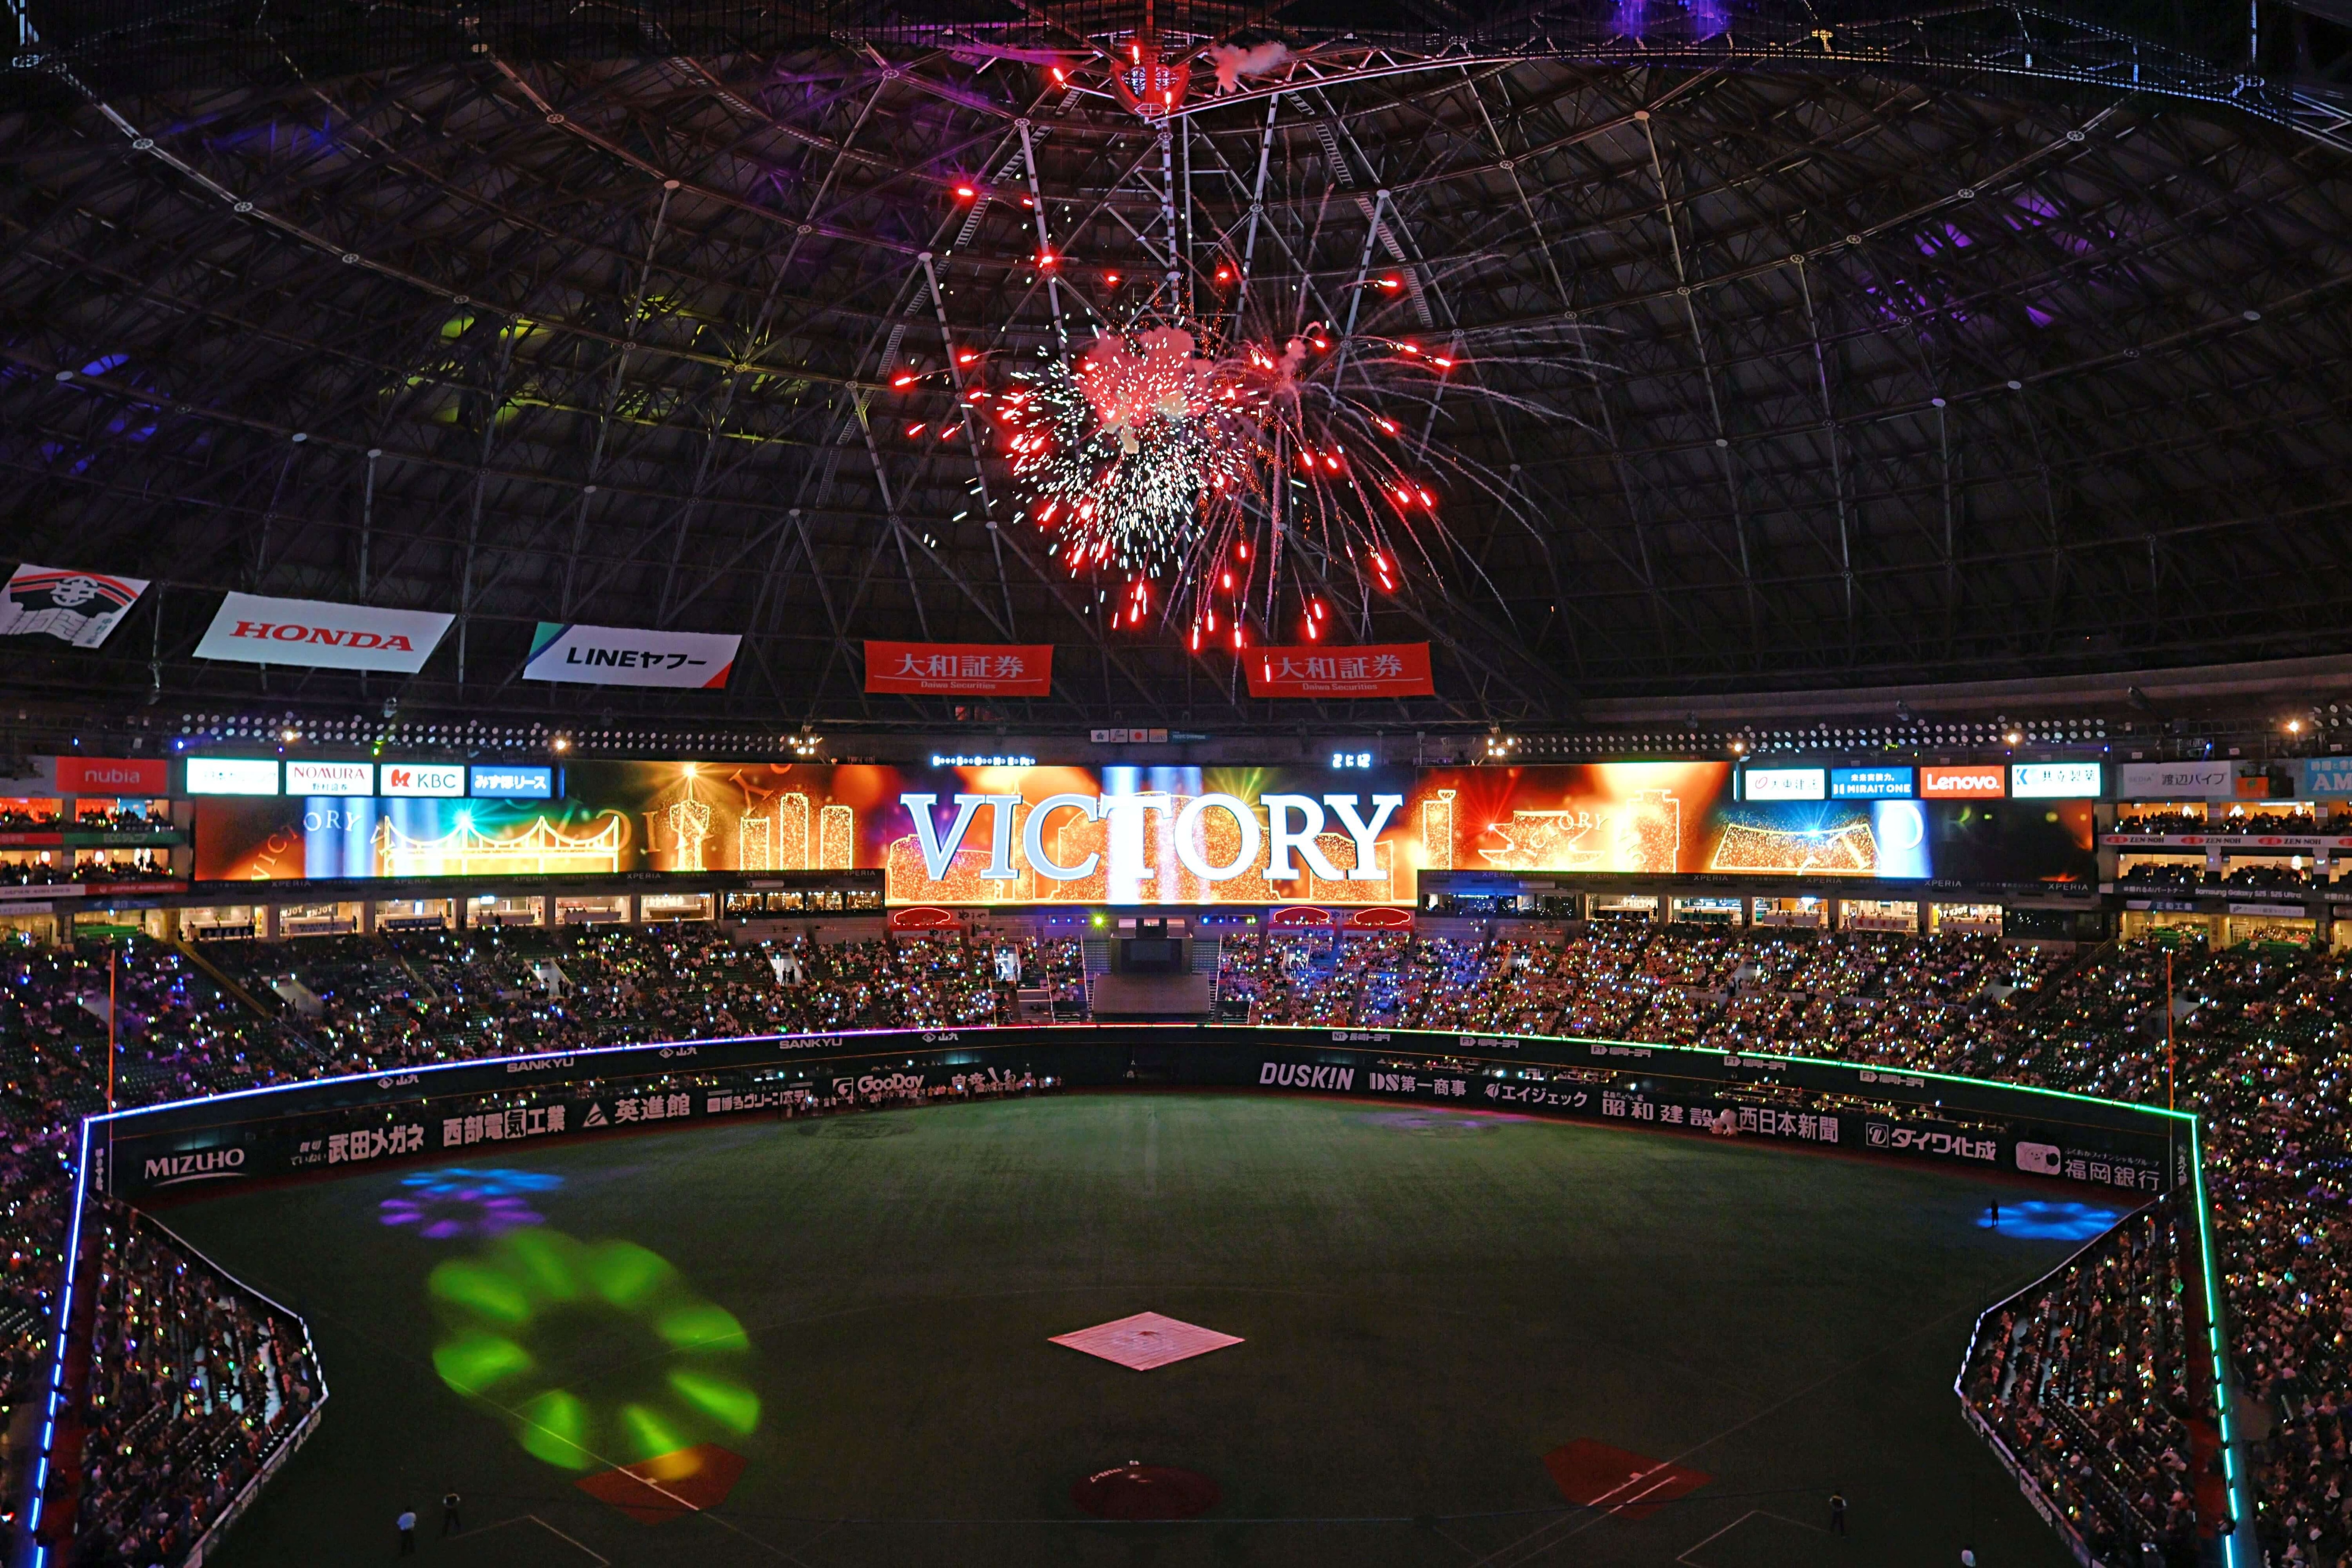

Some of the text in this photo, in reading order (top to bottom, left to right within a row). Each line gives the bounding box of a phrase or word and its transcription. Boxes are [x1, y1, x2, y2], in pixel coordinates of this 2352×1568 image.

[230, 620, 414, 652] HONDA
[566, 646, 707, 670] LINEヤフー
[895, 653, 1024, 678] 大和証券
[1274, 654, 1402, 679] 大和証券
[85, 767, 140, 783] nubia
[294, 766, 365, 780] NOMURA
[417, 773, 456, 789] KBC
[474, 773, 547, 789] みずほリース
[1927, 773, 1996, 790] Lenovo
[1847, 783, 1911, 793] MIRAIT ONE
[900, 793, 1403, 881] VICTORY
[2195, 888, 2227, 897] Samsung
[779, 1038, 842, 1050] SANKYU
[938, 1032, 958, 1041] 山九
[676, 1047, 697, 1057] 山九
[507, 1058, 574, 1073] SANKYU
[396, 1074, 419, 1086] 山九
[1369, 1072, 1466, 1097] DS 第一商事
[614, 1092, 690, 1124] 英進館
[1502, 1085, 1588, 1108] エイジェック
[1602, 1098, 1714, 1128] 昭和建設
[1740, 1106, 1838, 1143] 西日本新聞
[443, 1105, 566, 1147] 西部電気工業
[328, 1123, 424, 1164] 武田メガネ
[1891, 1128, 1997, 1161] ダイワ化成
[144, 1148, 245, 1179] MIZUHO
[2065, 1159, 2160, 1191] 福岡銀行
